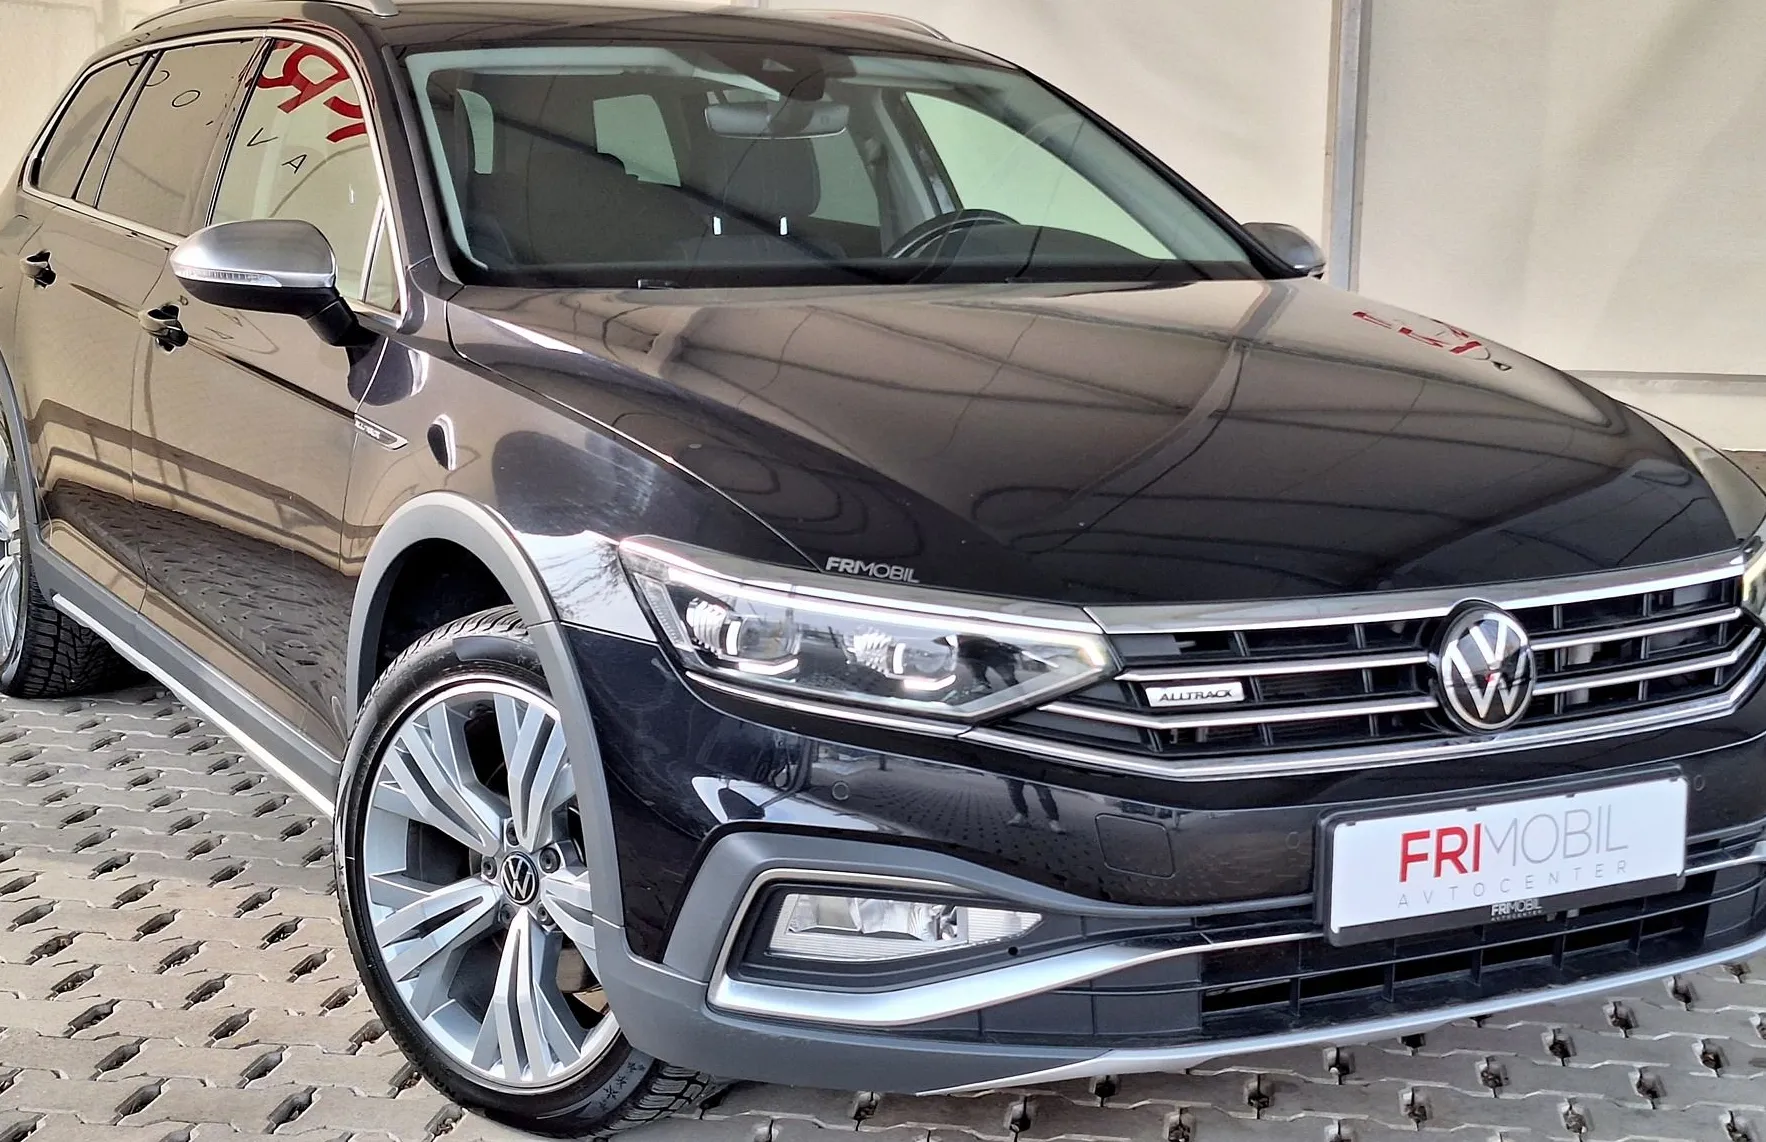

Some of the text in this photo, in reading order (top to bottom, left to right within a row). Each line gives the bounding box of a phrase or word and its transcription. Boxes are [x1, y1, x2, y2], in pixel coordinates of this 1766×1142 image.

[825, 556, 920, 583] FRIMOBIL
[1160, 689, 1232, 701] ALLTRACK
[1399, 804, 1628, 882] FRIMOBIL
[1397, 861, 1627, 908] AVTOCENTER
[1491, 898, 1543, 916] FRIMOBIL
